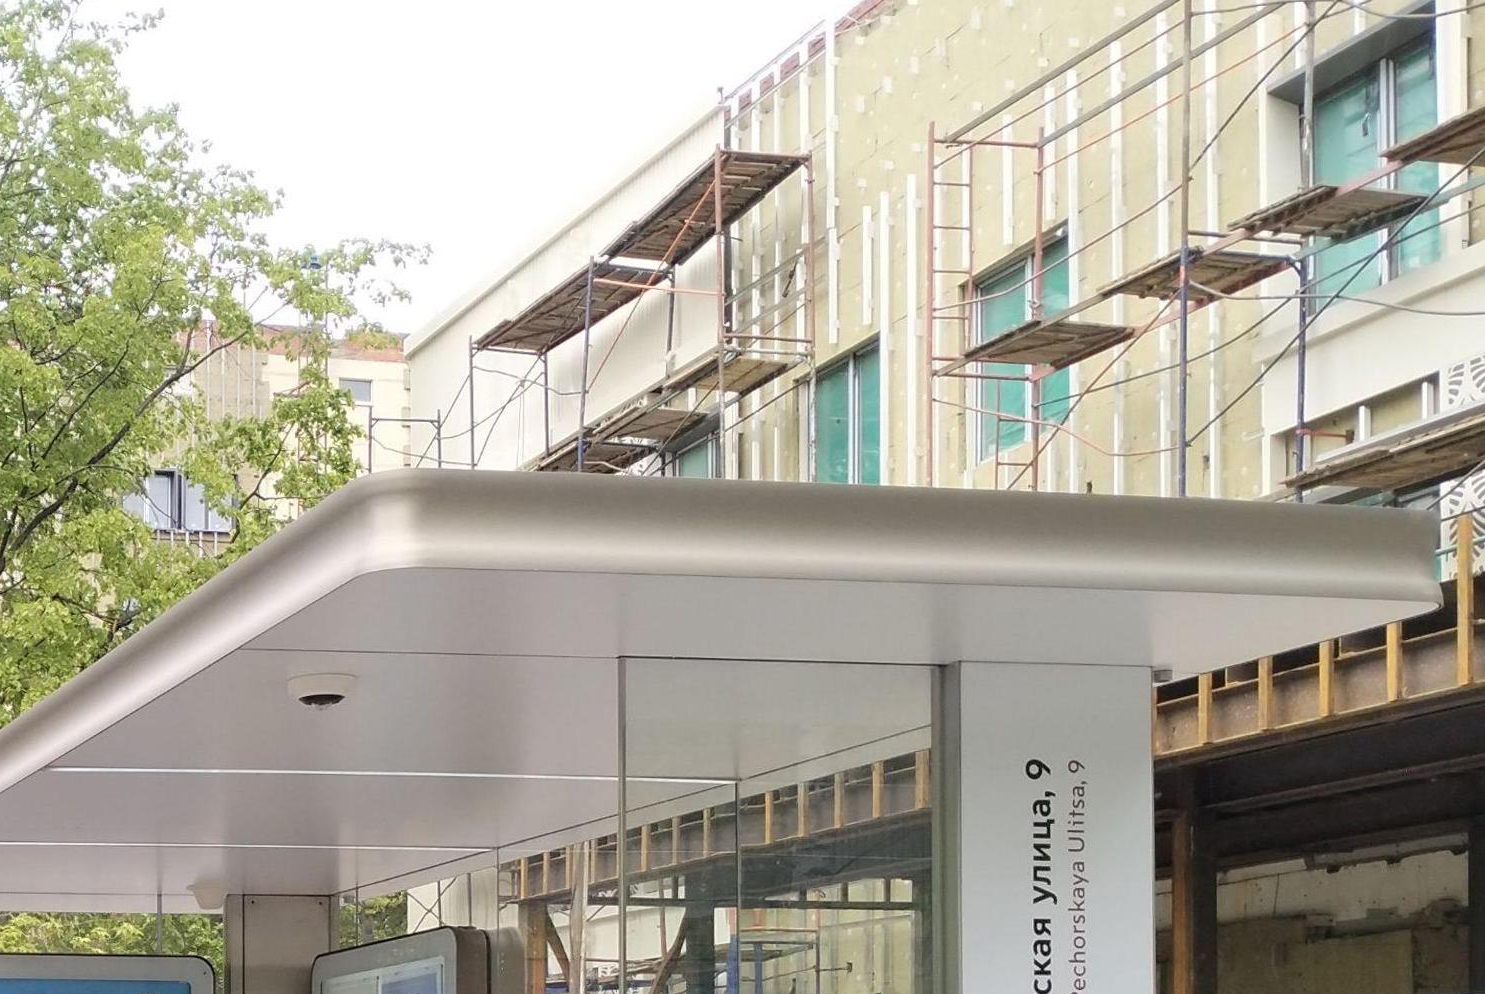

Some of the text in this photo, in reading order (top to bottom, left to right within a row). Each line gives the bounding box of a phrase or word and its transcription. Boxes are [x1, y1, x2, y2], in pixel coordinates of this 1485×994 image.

[1026, 759, 1052, 780] 9
[1067, 760, 1086, 773] 9
[1067, 780, 1087, 852] Ulitsa,
[1032, 790, 1057, 905] улица,
